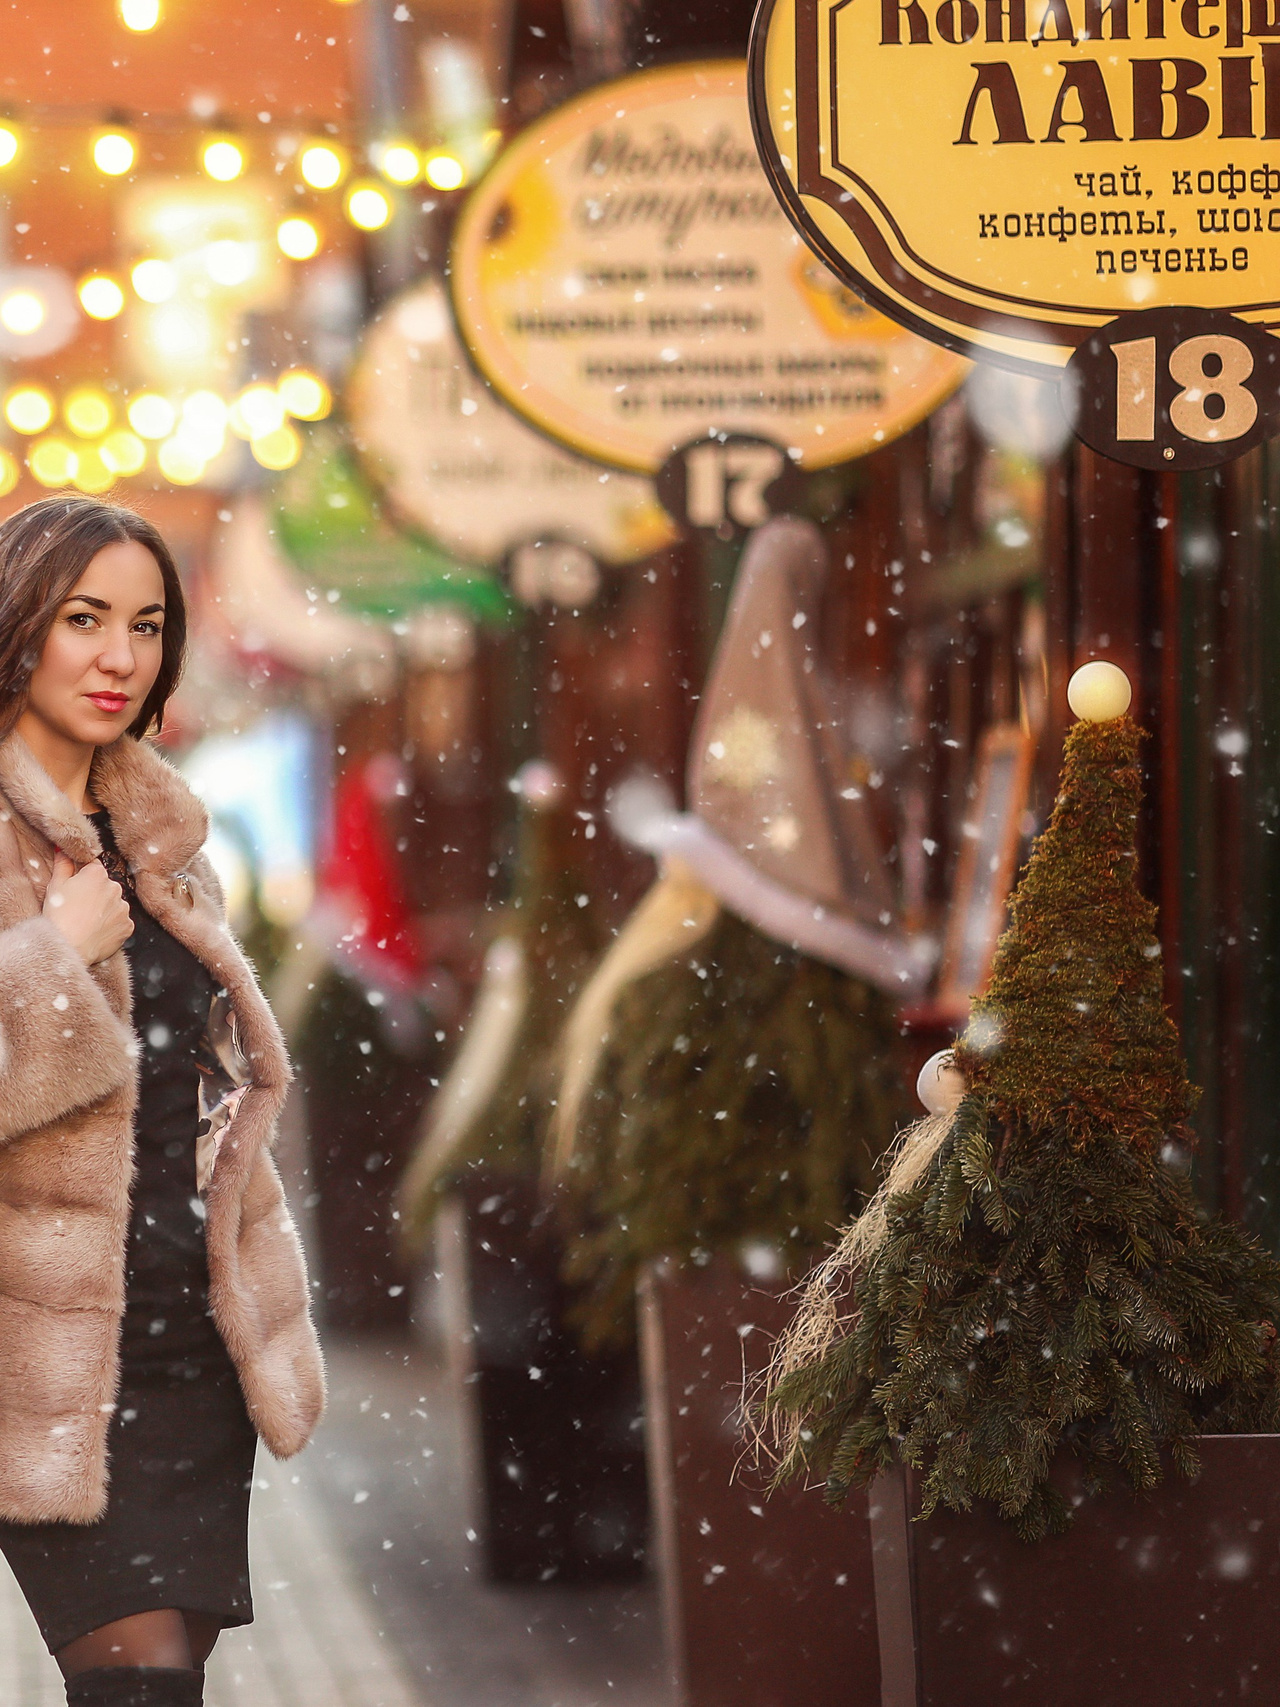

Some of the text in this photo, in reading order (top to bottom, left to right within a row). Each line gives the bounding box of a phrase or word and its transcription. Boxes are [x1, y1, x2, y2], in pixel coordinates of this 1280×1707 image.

[1074, 165, 1153, 200] чай,
[978, 206, 1177, 242] конфеты,
[1096, 248, 1249, 275] печенье
[1109, 334, 1258, 443] 18
